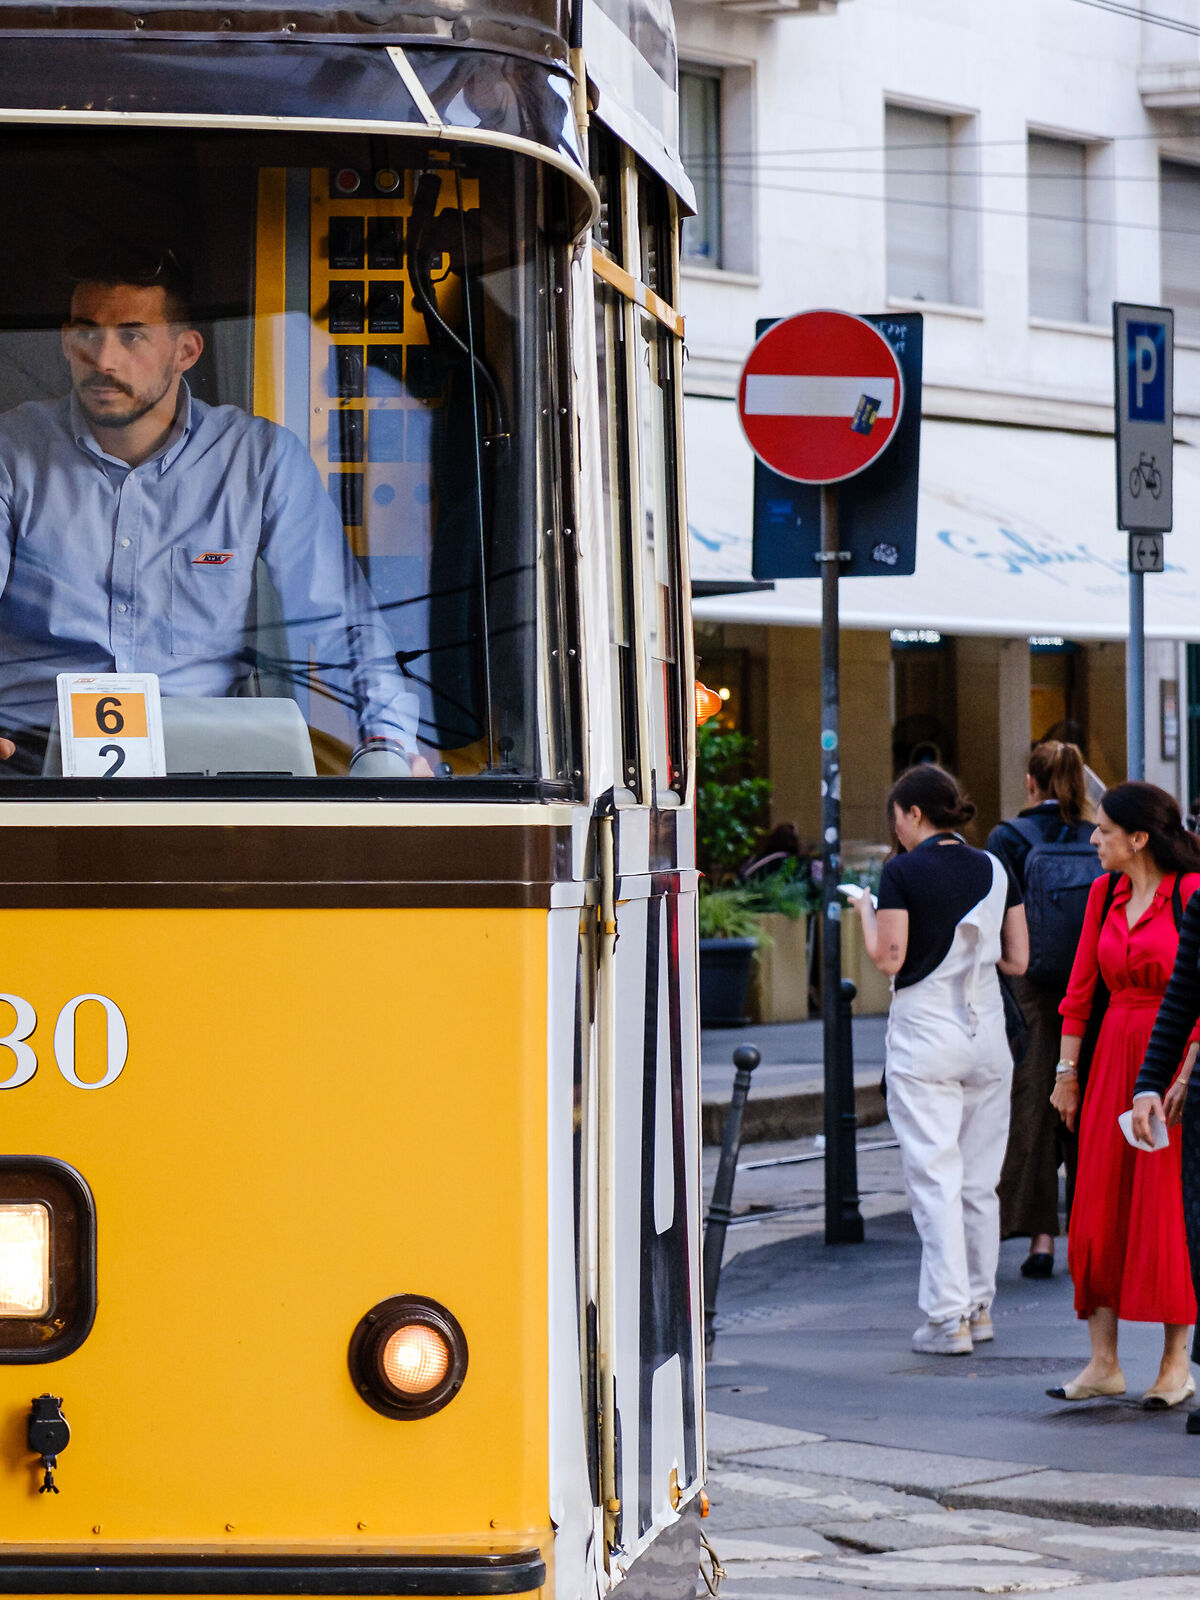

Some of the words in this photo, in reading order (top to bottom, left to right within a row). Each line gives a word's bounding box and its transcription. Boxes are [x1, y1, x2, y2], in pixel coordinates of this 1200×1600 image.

[1135, 334, 1157, 408] P
[95, 696, 125, 735] 6
[98, 743, 126, 778] 2
